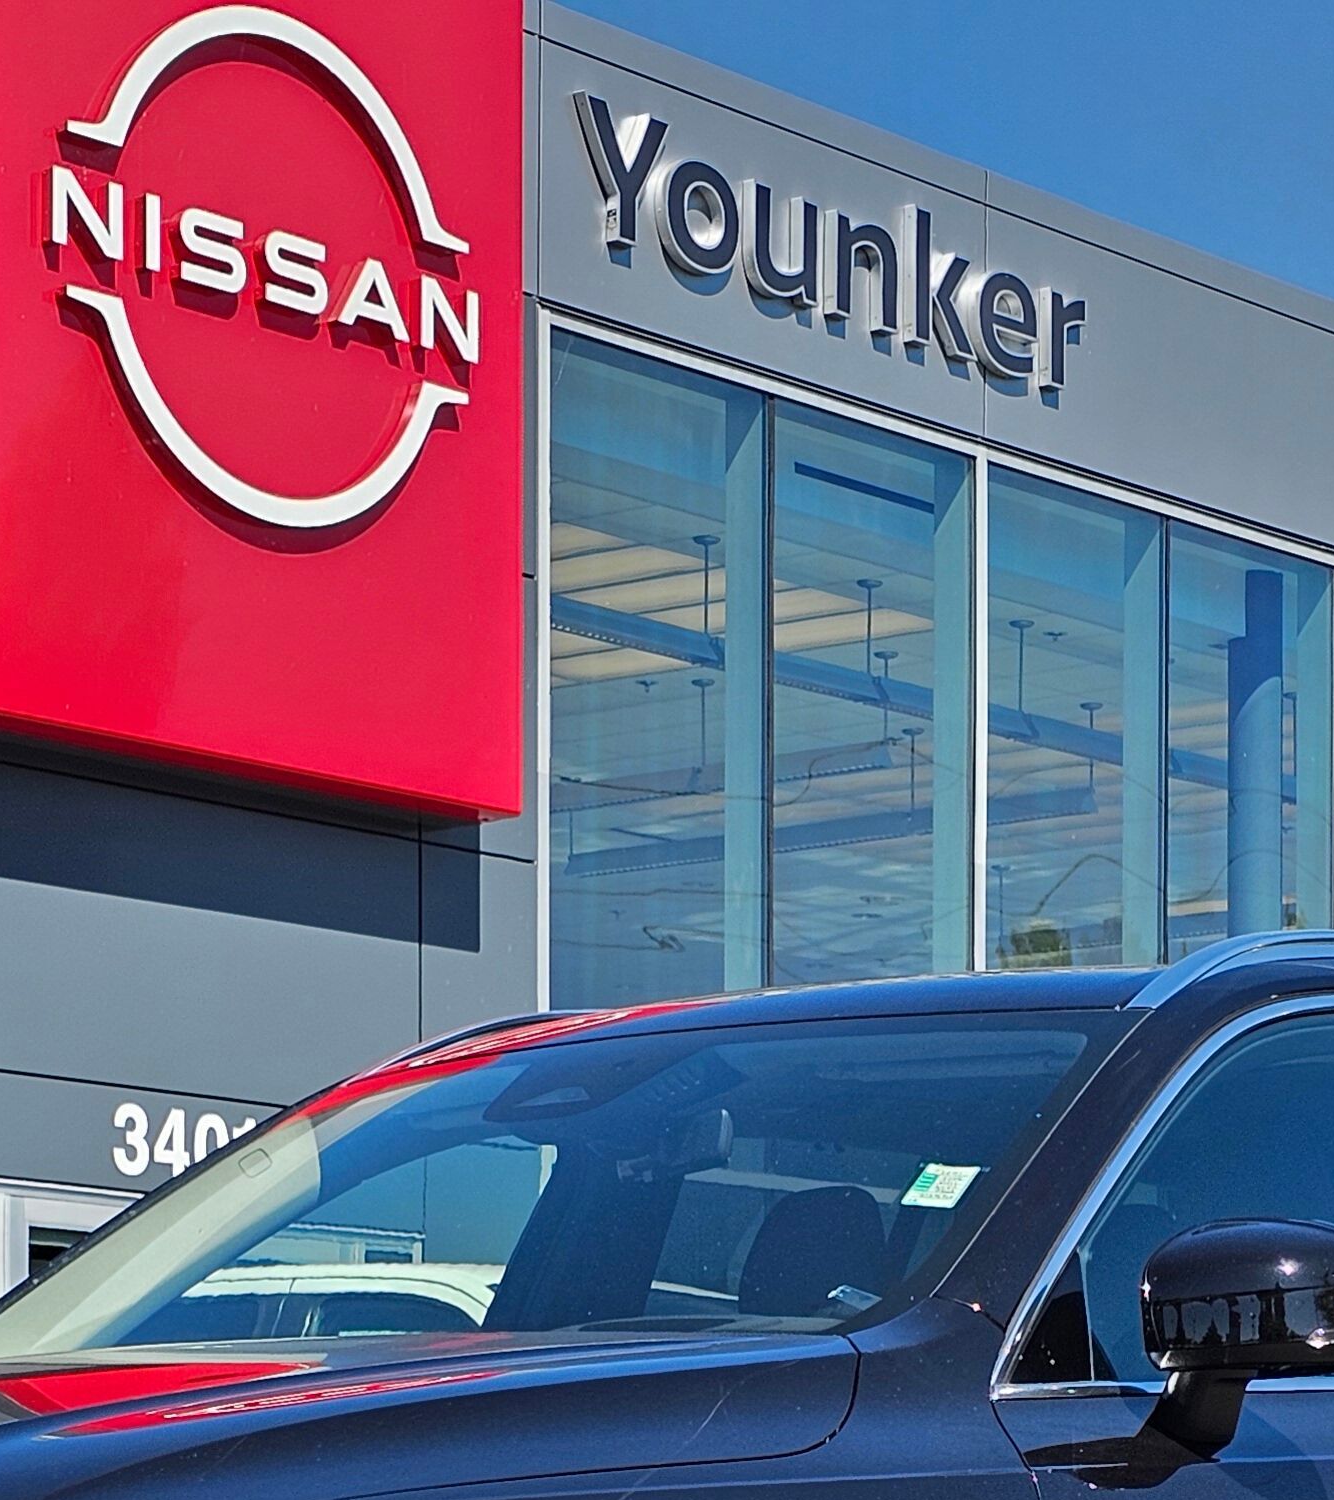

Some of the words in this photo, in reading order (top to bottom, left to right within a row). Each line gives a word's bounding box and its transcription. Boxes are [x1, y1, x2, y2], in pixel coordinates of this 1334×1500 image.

[51, 163, 481, 366] NISSAN
[571, 89, 1087, 392] Younker
[112, 1101, 258, 1178] 340
